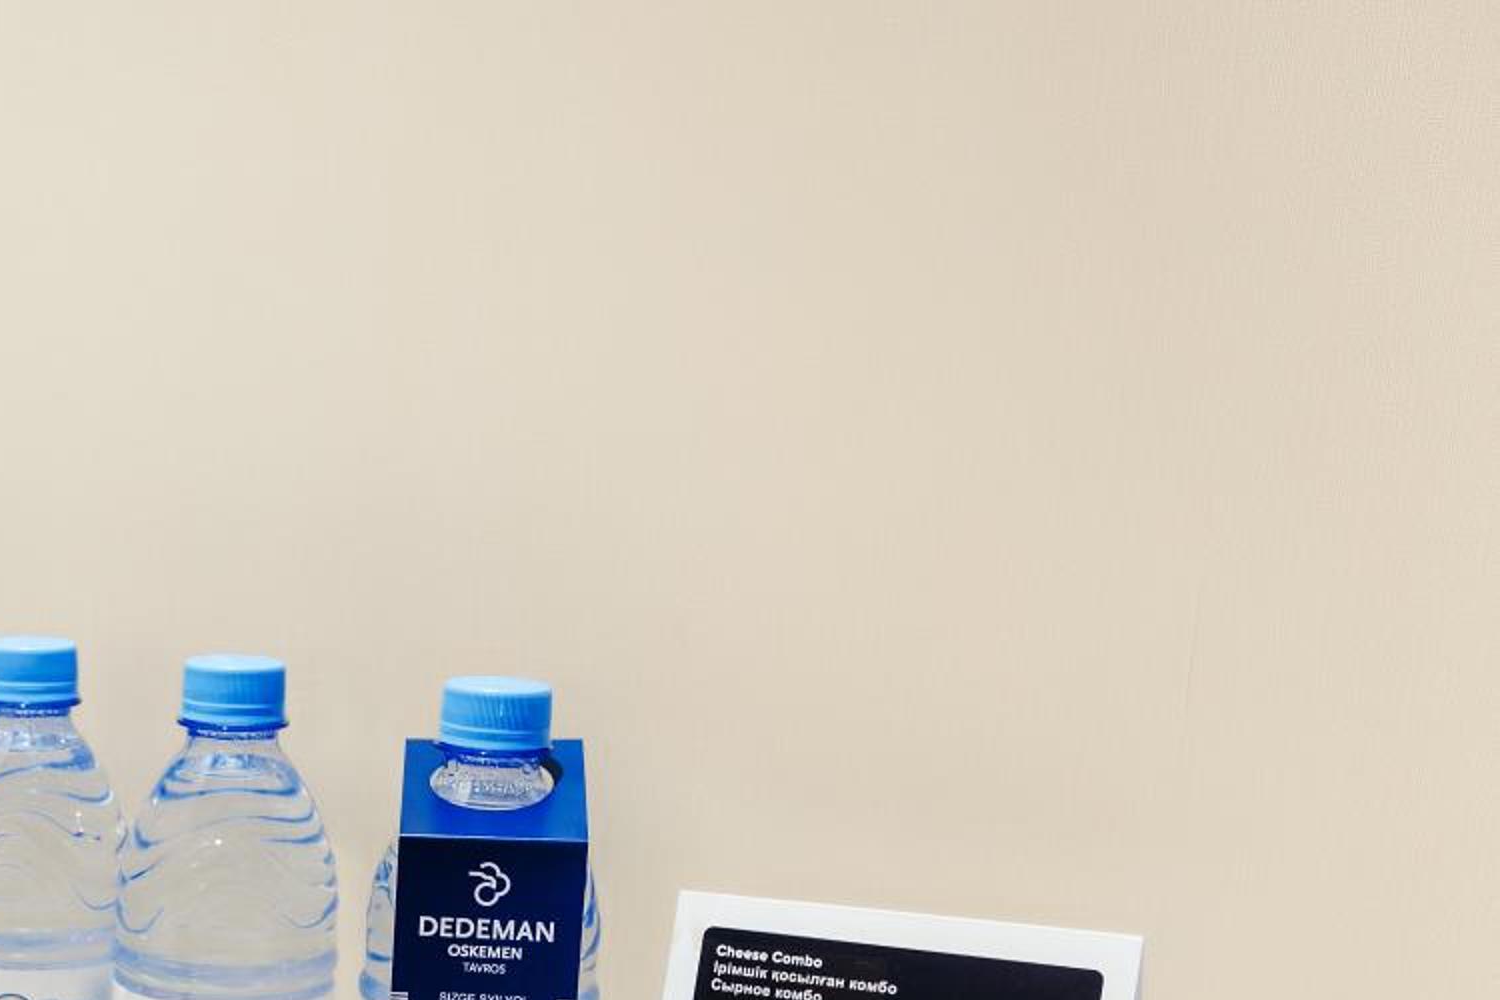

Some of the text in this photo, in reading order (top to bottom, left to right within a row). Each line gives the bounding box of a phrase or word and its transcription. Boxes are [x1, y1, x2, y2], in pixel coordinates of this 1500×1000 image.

[419, 915, 555, 943] DEDEMAN
[447, 944, 523, 960] OSKEMEN
[716, 944, 823, 968] Cheese Combo
[463, 962, 506, 975] TAVROS
[711, 978, 771, 997] Сырное
[849, 979, 898, 995] комбо
